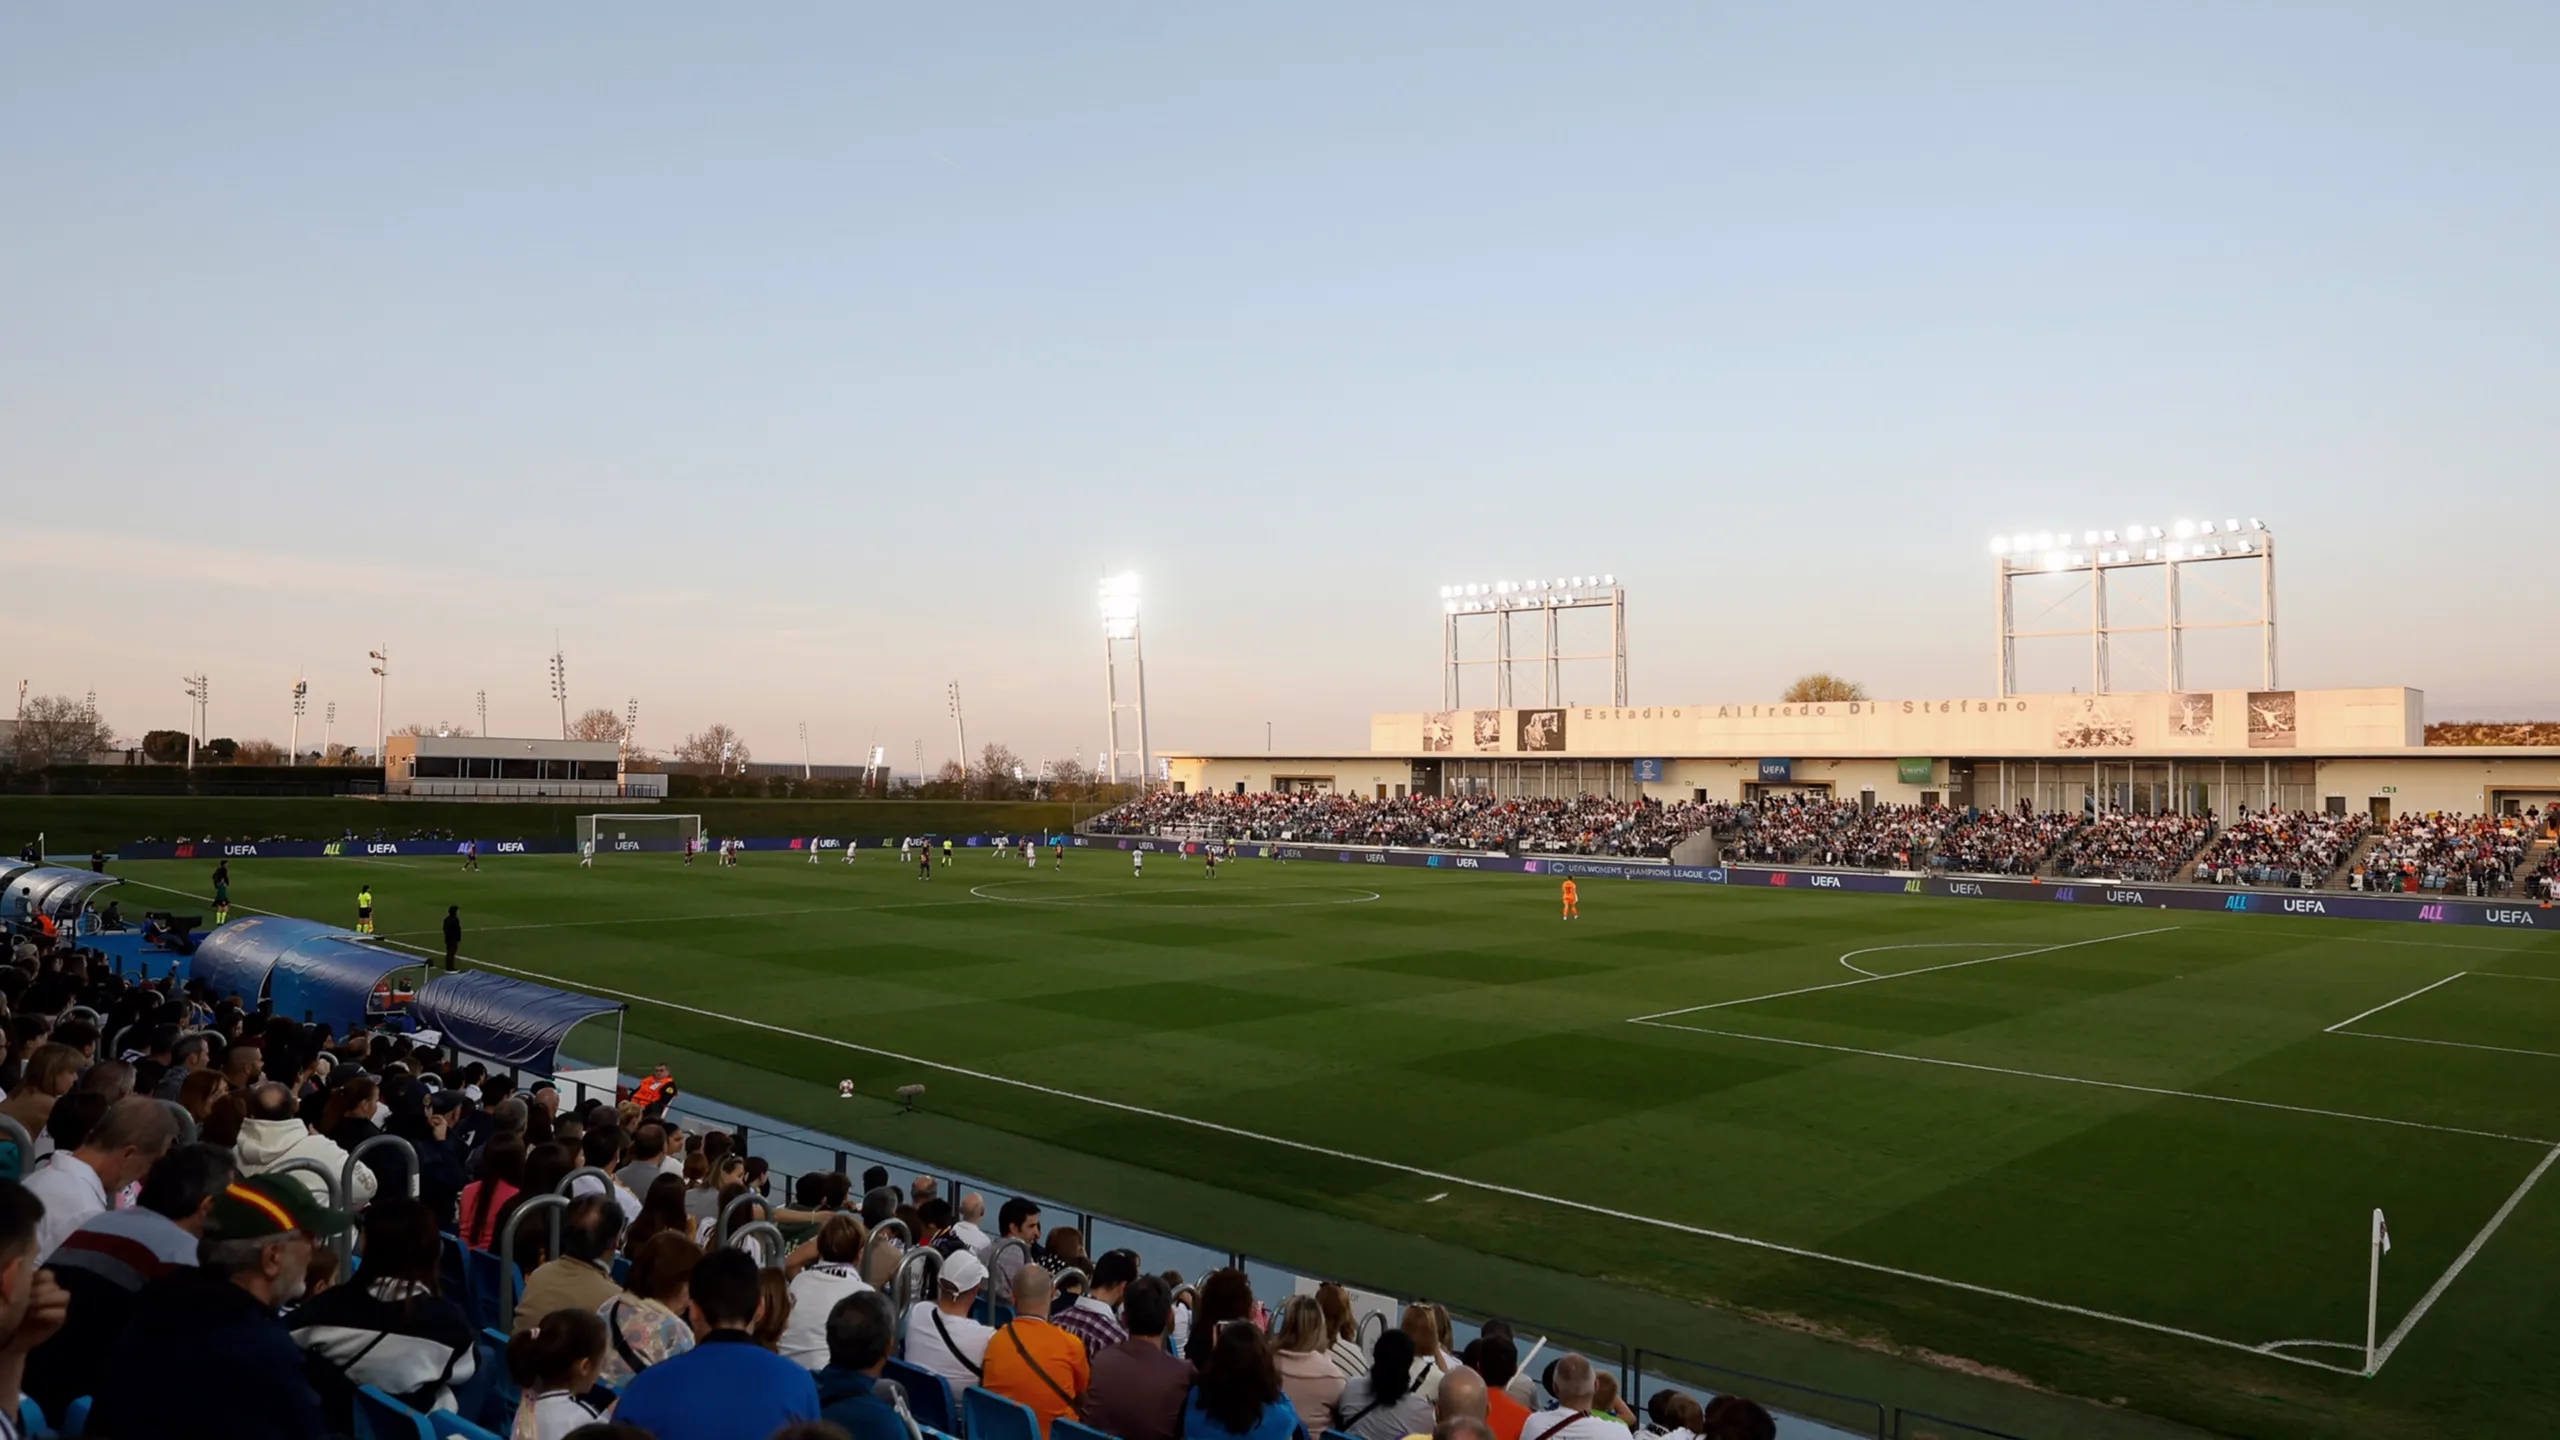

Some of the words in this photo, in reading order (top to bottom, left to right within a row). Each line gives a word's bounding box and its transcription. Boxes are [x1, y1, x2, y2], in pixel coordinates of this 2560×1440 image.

[1584, 706, 1681, 720] Estadio
[1718, 703, 1826, 717] Alfredo
[1849, 702, 1876, 715] Di
[1903, 699, 2027, 714] Stéfano
[1762, 765, 1786, 774] UEFA
[323, 843, 341, 855] ALL
[367, 843, 398, 854] UEFA
[457, 842, 473, 853] AL
[497, 842, 525, 852] UEFA
[614, 841, 640, 851] UEFA
[819, 838, 841, 848] UEFA
[1138, 841, 1155, 850] UEFA
[224, 845, 258, 856] UEFA
[1283, 849, 1302, 858] UEFA
[1366, 853, 1386, 863] UEFA
[1427, 855, 1440, 867] ALL
[1456, 857, 1479, 869] UEFA
[1524, 860, 1537, 873] ALL
[1568, 864, 1587, 873] UEFA
[1587, 865, 1622, 875] WOMEN'S
[1624, 867, 1671, 877] CHAMPIONS
[1673, 869, 1703, 879] LEAGUE
[1770, 872, 1788, 886] ALL
[1811, 875, 1841, 888] UEFA
[1903, 879, 1921, 893] ALL
[1949, 883, 1983, 896] UEFA
[2055, 887, 2074, 902] ALL
[2106, 890, 2144, 904] UEFA
[2225, 895, 2248, 910] ALL
[2283, 899, 2326, 914] UEFA
[2418, 904, 2444, 920] ALL
[2485, 909, 2534, 924] UEFA
